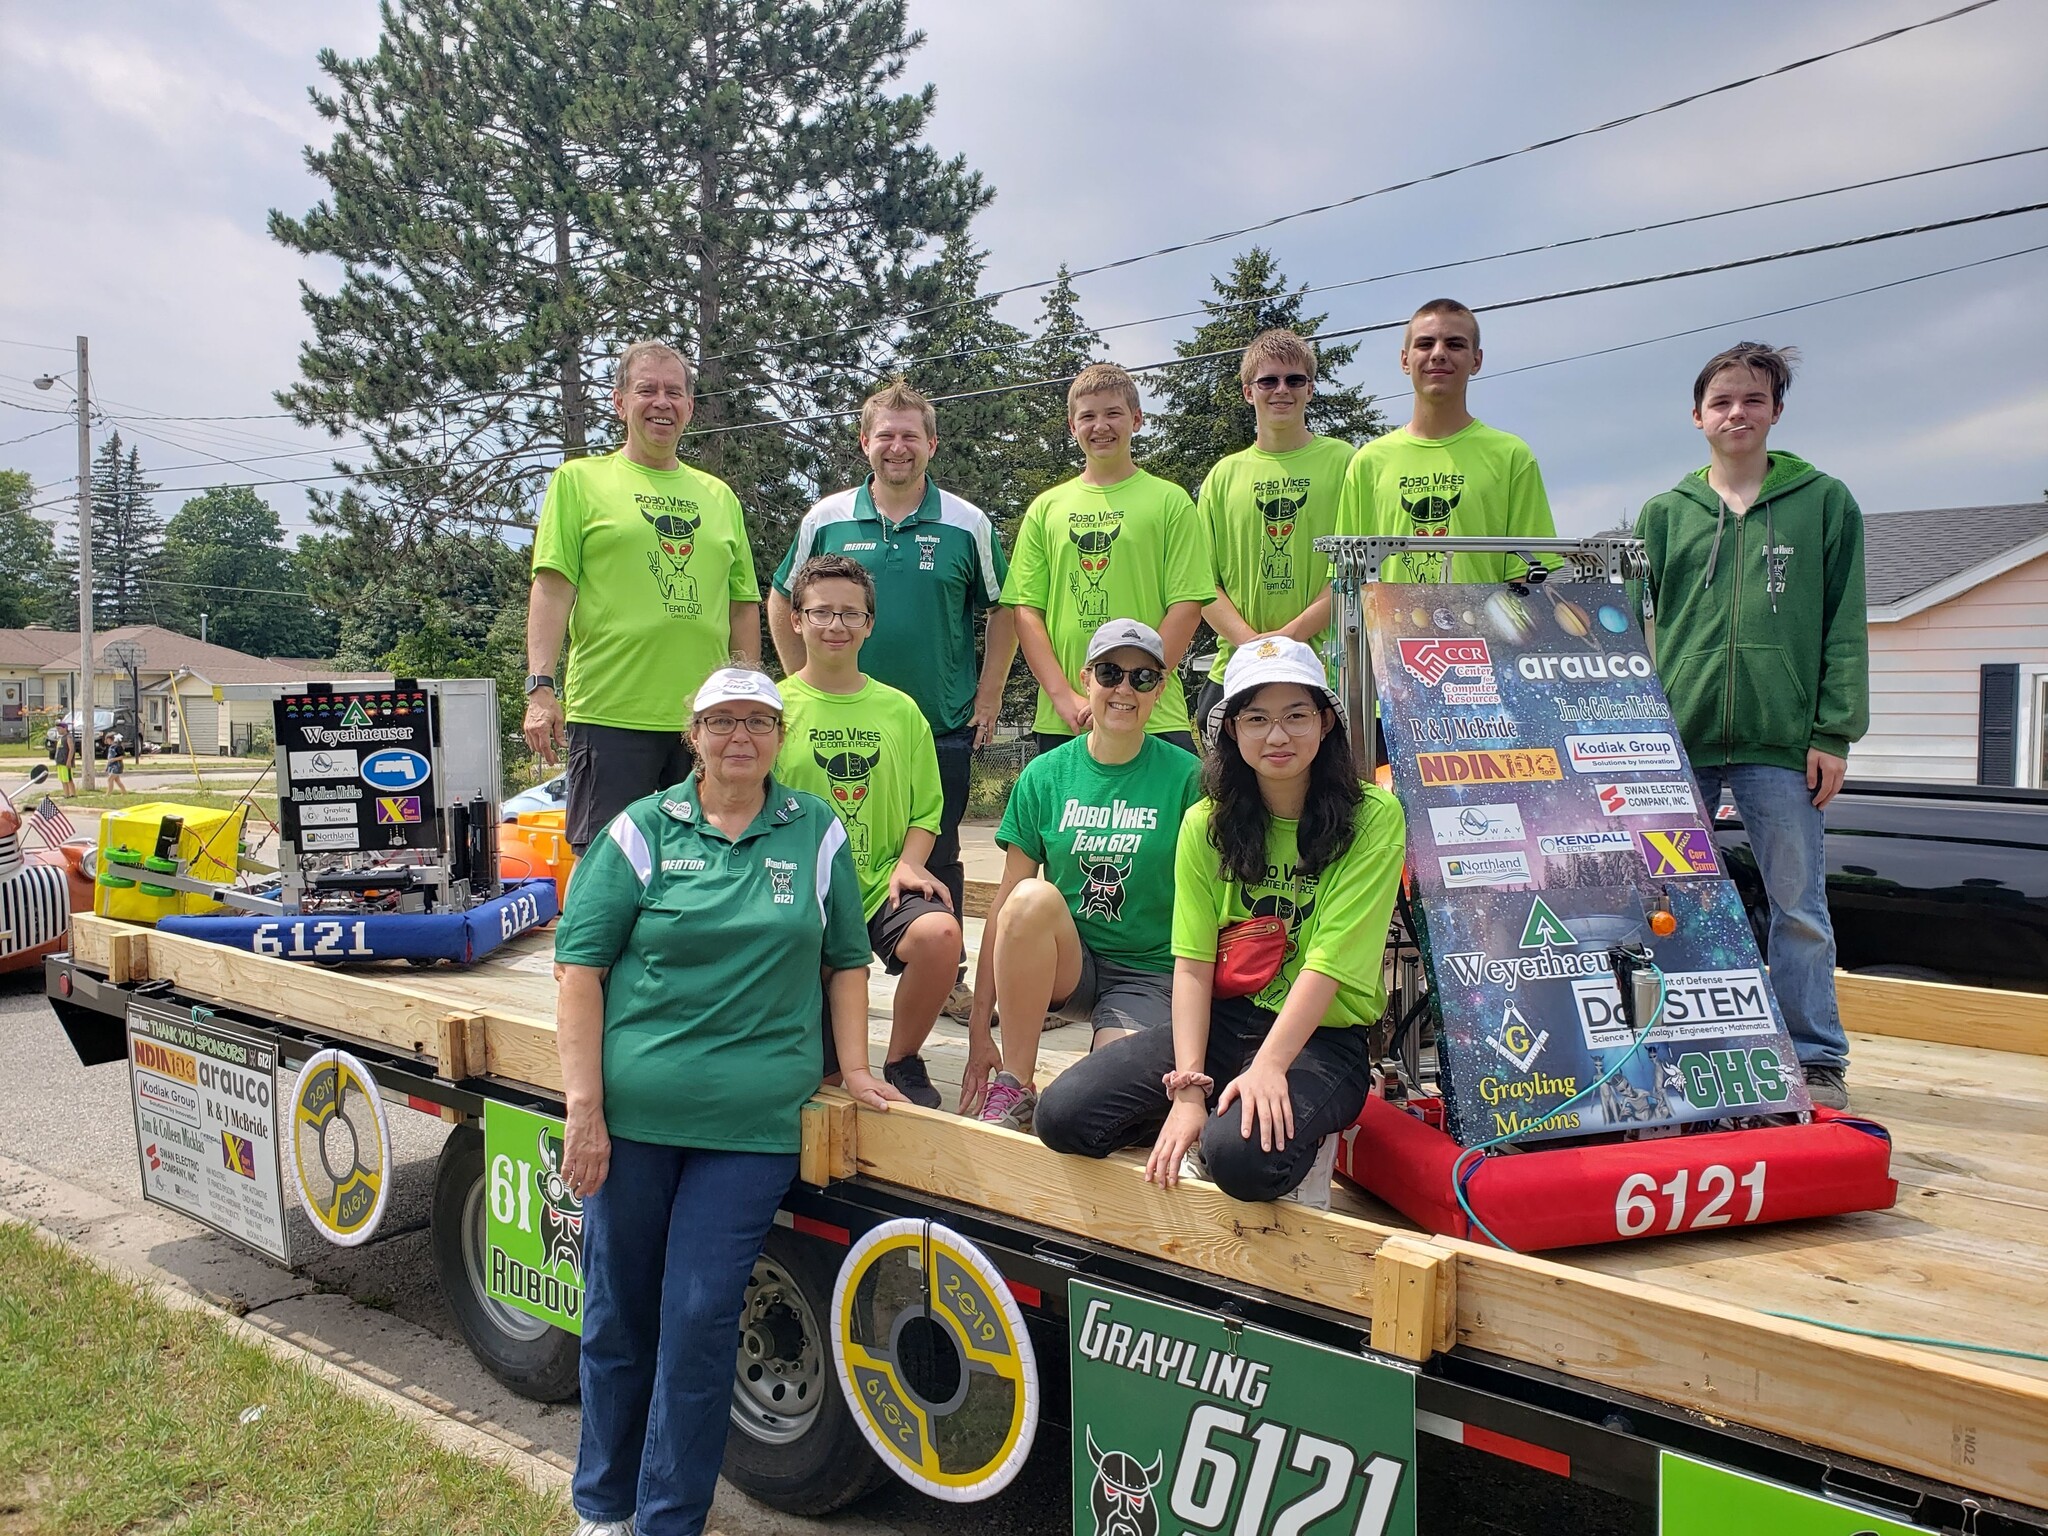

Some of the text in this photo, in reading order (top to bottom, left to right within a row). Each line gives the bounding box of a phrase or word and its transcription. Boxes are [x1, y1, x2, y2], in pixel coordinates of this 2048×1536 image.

[1282, 477, 1310, 487] VIKES
[1433, 472, 1465, 485] VIKES
[667, 496, 698, 509] VIKES
[1098, 511, 1124, 521] VIKES
[843, 543, 877, 552] MENTOR
[919, 561, 935, 571] 6121
[1445, 648, 1485, 660] CCR
[1456, 667, 1492, 676] Center
[1519, 654, 1650, 679] arauco
[1443, 683, 1496, 694] Computer
[1446, 694, 1499, 703] Resources
[1559, 699, 1579, 720] Jim
[1579, 698, 1590, 719] &
[301, 726, 413, 747] Weyerhaeuser
[846, 728, 881, 742] VIKES
[1411, 716, 1516, 744] R & J McBride
[1577, 741, 1671, 755] Kodiak Group
[1625, 785, 1690, 795] SWAN ELECTRIC
[1673, 797, 1690, 806] INC.
[1058, 798, 1158, 832] ROBO VIKES
[1070, 829, 1142, 855] TEAM 6121
[1555, 833, 1631, 846] KENDALL
[661, 860, 705, 872] MENTOR
[1461, 857, 1521, 871] Northland
[774, 894, 794, 904] 6121
[502, 893, 540, 941] 6121
[253, 921, 373, 957] 6121
[1677, 978, 1685, 986] of
[1687, 976, 1723, 985] Defense
[150, 1020, 178, 1041] THANK
[177, 1028, 196, 1047] YOU
[1592, 1033, 1625, 1043] Science
[1679, 1025, 1724, 1038] Engineering
[257, 1051, 272, 1070] 6121
[200, 1061, 270, 1108] arauco
[1479, 1072, 1577, 1106] Grayling
[1677, 1047, 1789, 1110] GHS
[142, 1080, 196, 1112] Kodiak Group
[309, 1076, 334, 1108] 2019
[207, 1099, 269, 1140] R & J McBride
[1493, 1110, 1580, 1137] Masons
[159, 1147, 200, 1172] SWAN ELECTRIC
[342, 1188, 368, 1220] 2019
[1615, 1160, 1767, 1236] 6121
[944, 1275, 996, 1342] 2019
[1078, 1300, 1272, 1409] GRAYLING
[866, 1378, 914, 1442] 2019
[1170, 1405, 1404, 1536] 6121
